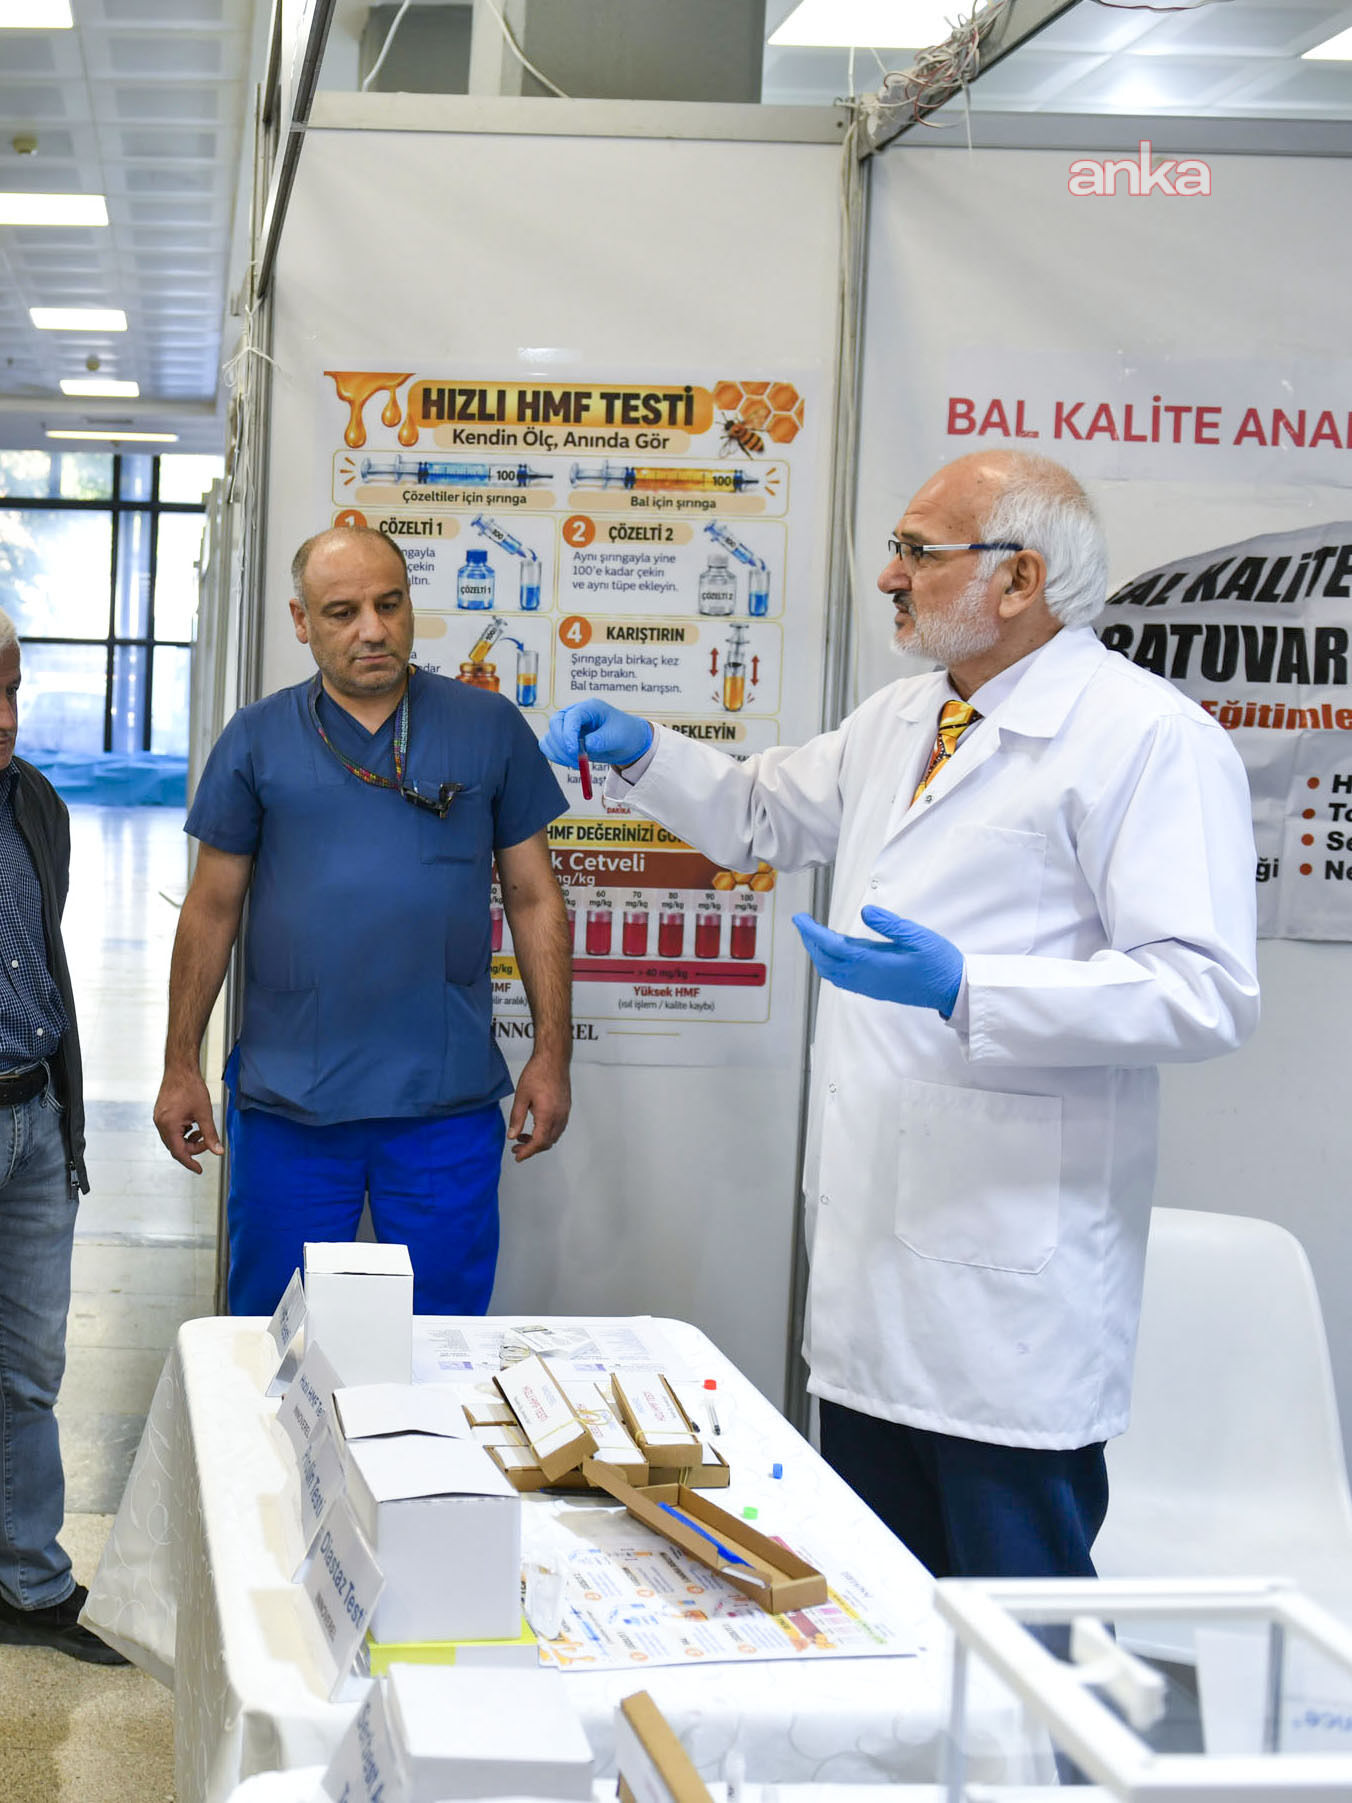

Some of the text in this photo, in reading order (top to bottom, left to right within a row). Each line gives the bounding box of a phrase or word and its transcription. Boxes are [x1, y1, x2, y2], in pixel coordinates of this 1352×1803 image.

[421, 385, 694, 426] HIZLI HMF TESTİ
[946, 395, 1352, 449] BAL KALİTE ANA
[452, 427, 670, 451] Kendin Ölç, Anında Gör
[496, 470, 516, 481] 100
[712, 475, 732, 487] 100
[402, 490, 527, 506] Çözeltiler için şırınga
[630, 496, 649, 508] Bal
[652, 497, 673, 509] için
[436, 521, 443, 536] 1
[572, 521, 674, 543] 2 ÇÖZELTİ 2
[400, 547, 436, 560] ngayla
[573, 551, 676, 564] Aynı şırıngayla yine
[604, 566, 635, 577] kadar
[637, 567, 665, 579] çekin
[572, 580, 679, 593] ve aynı tüpe ekleyin.
[1105, 572, 1189, 607] AL
[567, 622, 685, 644] 4 KARIŞTIRIN
[571, 653, 680, 668] Şırıngayla birkaç kez
[1100, 624, 1349, 685] RATUVAR
[570, 667, 599, 679] çekip
[570, 681, 587, 691] Bal
[588, 682, 639, 692] tamamen
[1201, 700, 1352, 730] Eğitimle
[576, 823, 654, 842] DEĞERİNİZİ
[569, 852, 645, 872] Cetveli
[595, 890, 606, 898] 60
[632, 891, 642, 899] 70
[589, 899, 612, 908] mg/kg
[625, 900, 648, 909] mg/kg
[662, 901, 684, 910] mg/kg
[633, 985, 701, 997] Yüksek HMF
[320, 1531, 347, 1596] Diastaz
